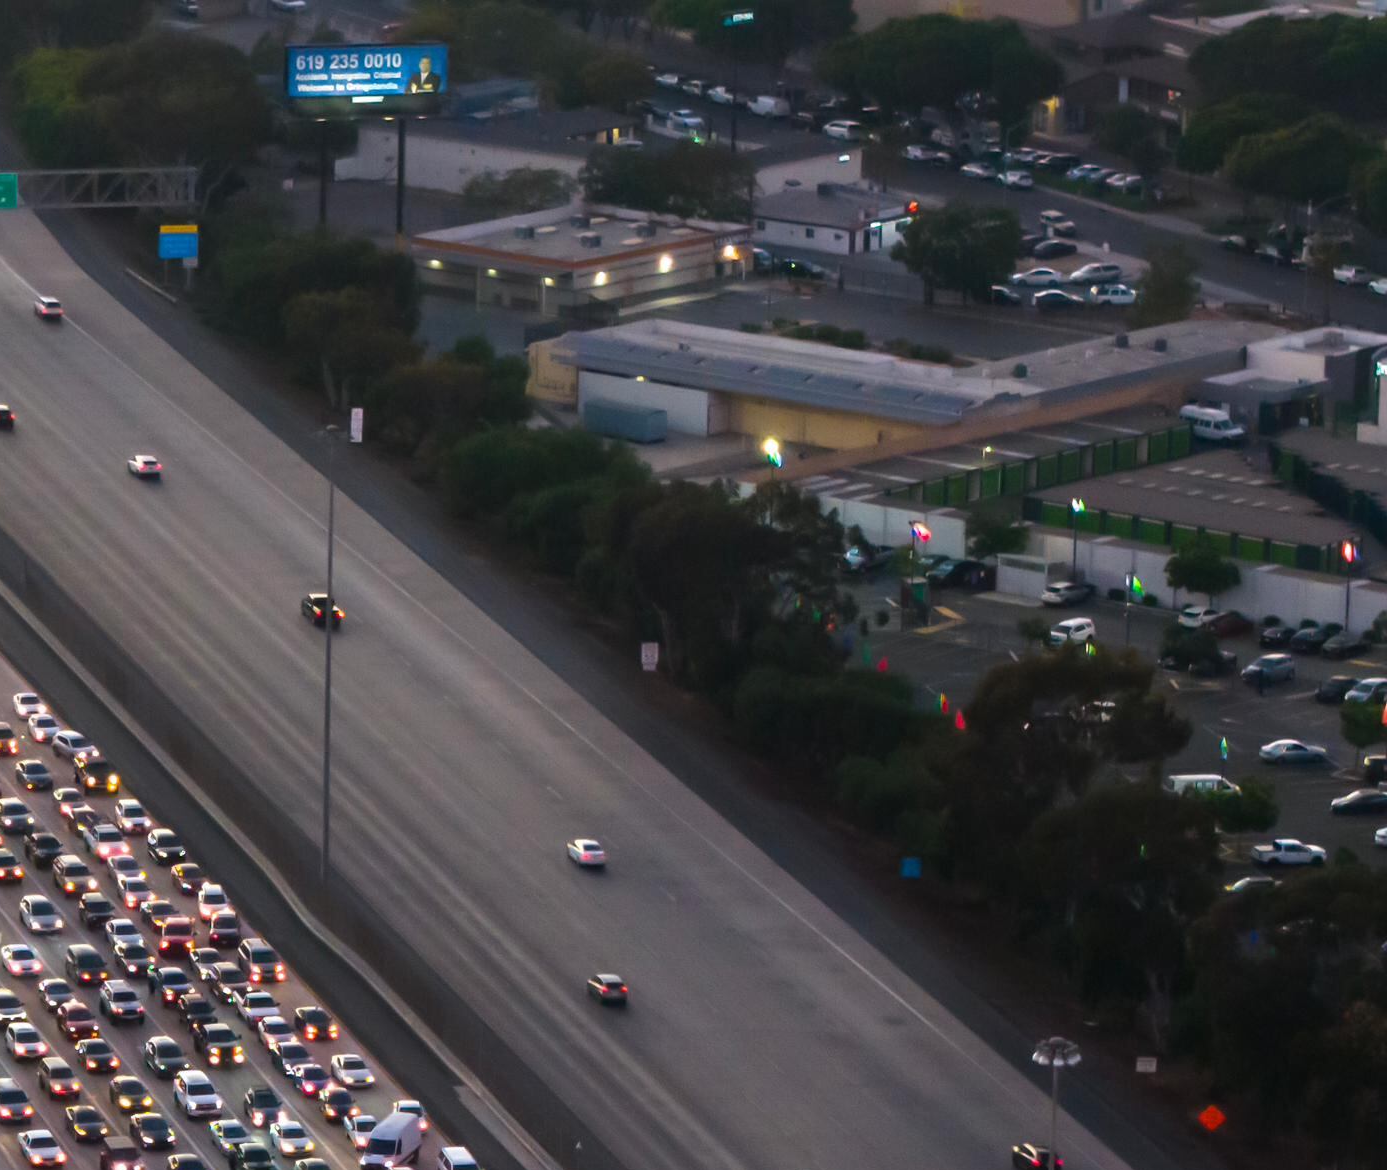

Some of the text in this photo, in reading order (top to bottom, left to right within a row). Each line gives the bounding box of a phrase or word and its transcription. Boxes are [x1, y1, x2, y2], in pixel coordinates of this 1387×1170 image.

[296, 52, 402, 70] 619 235 0010
